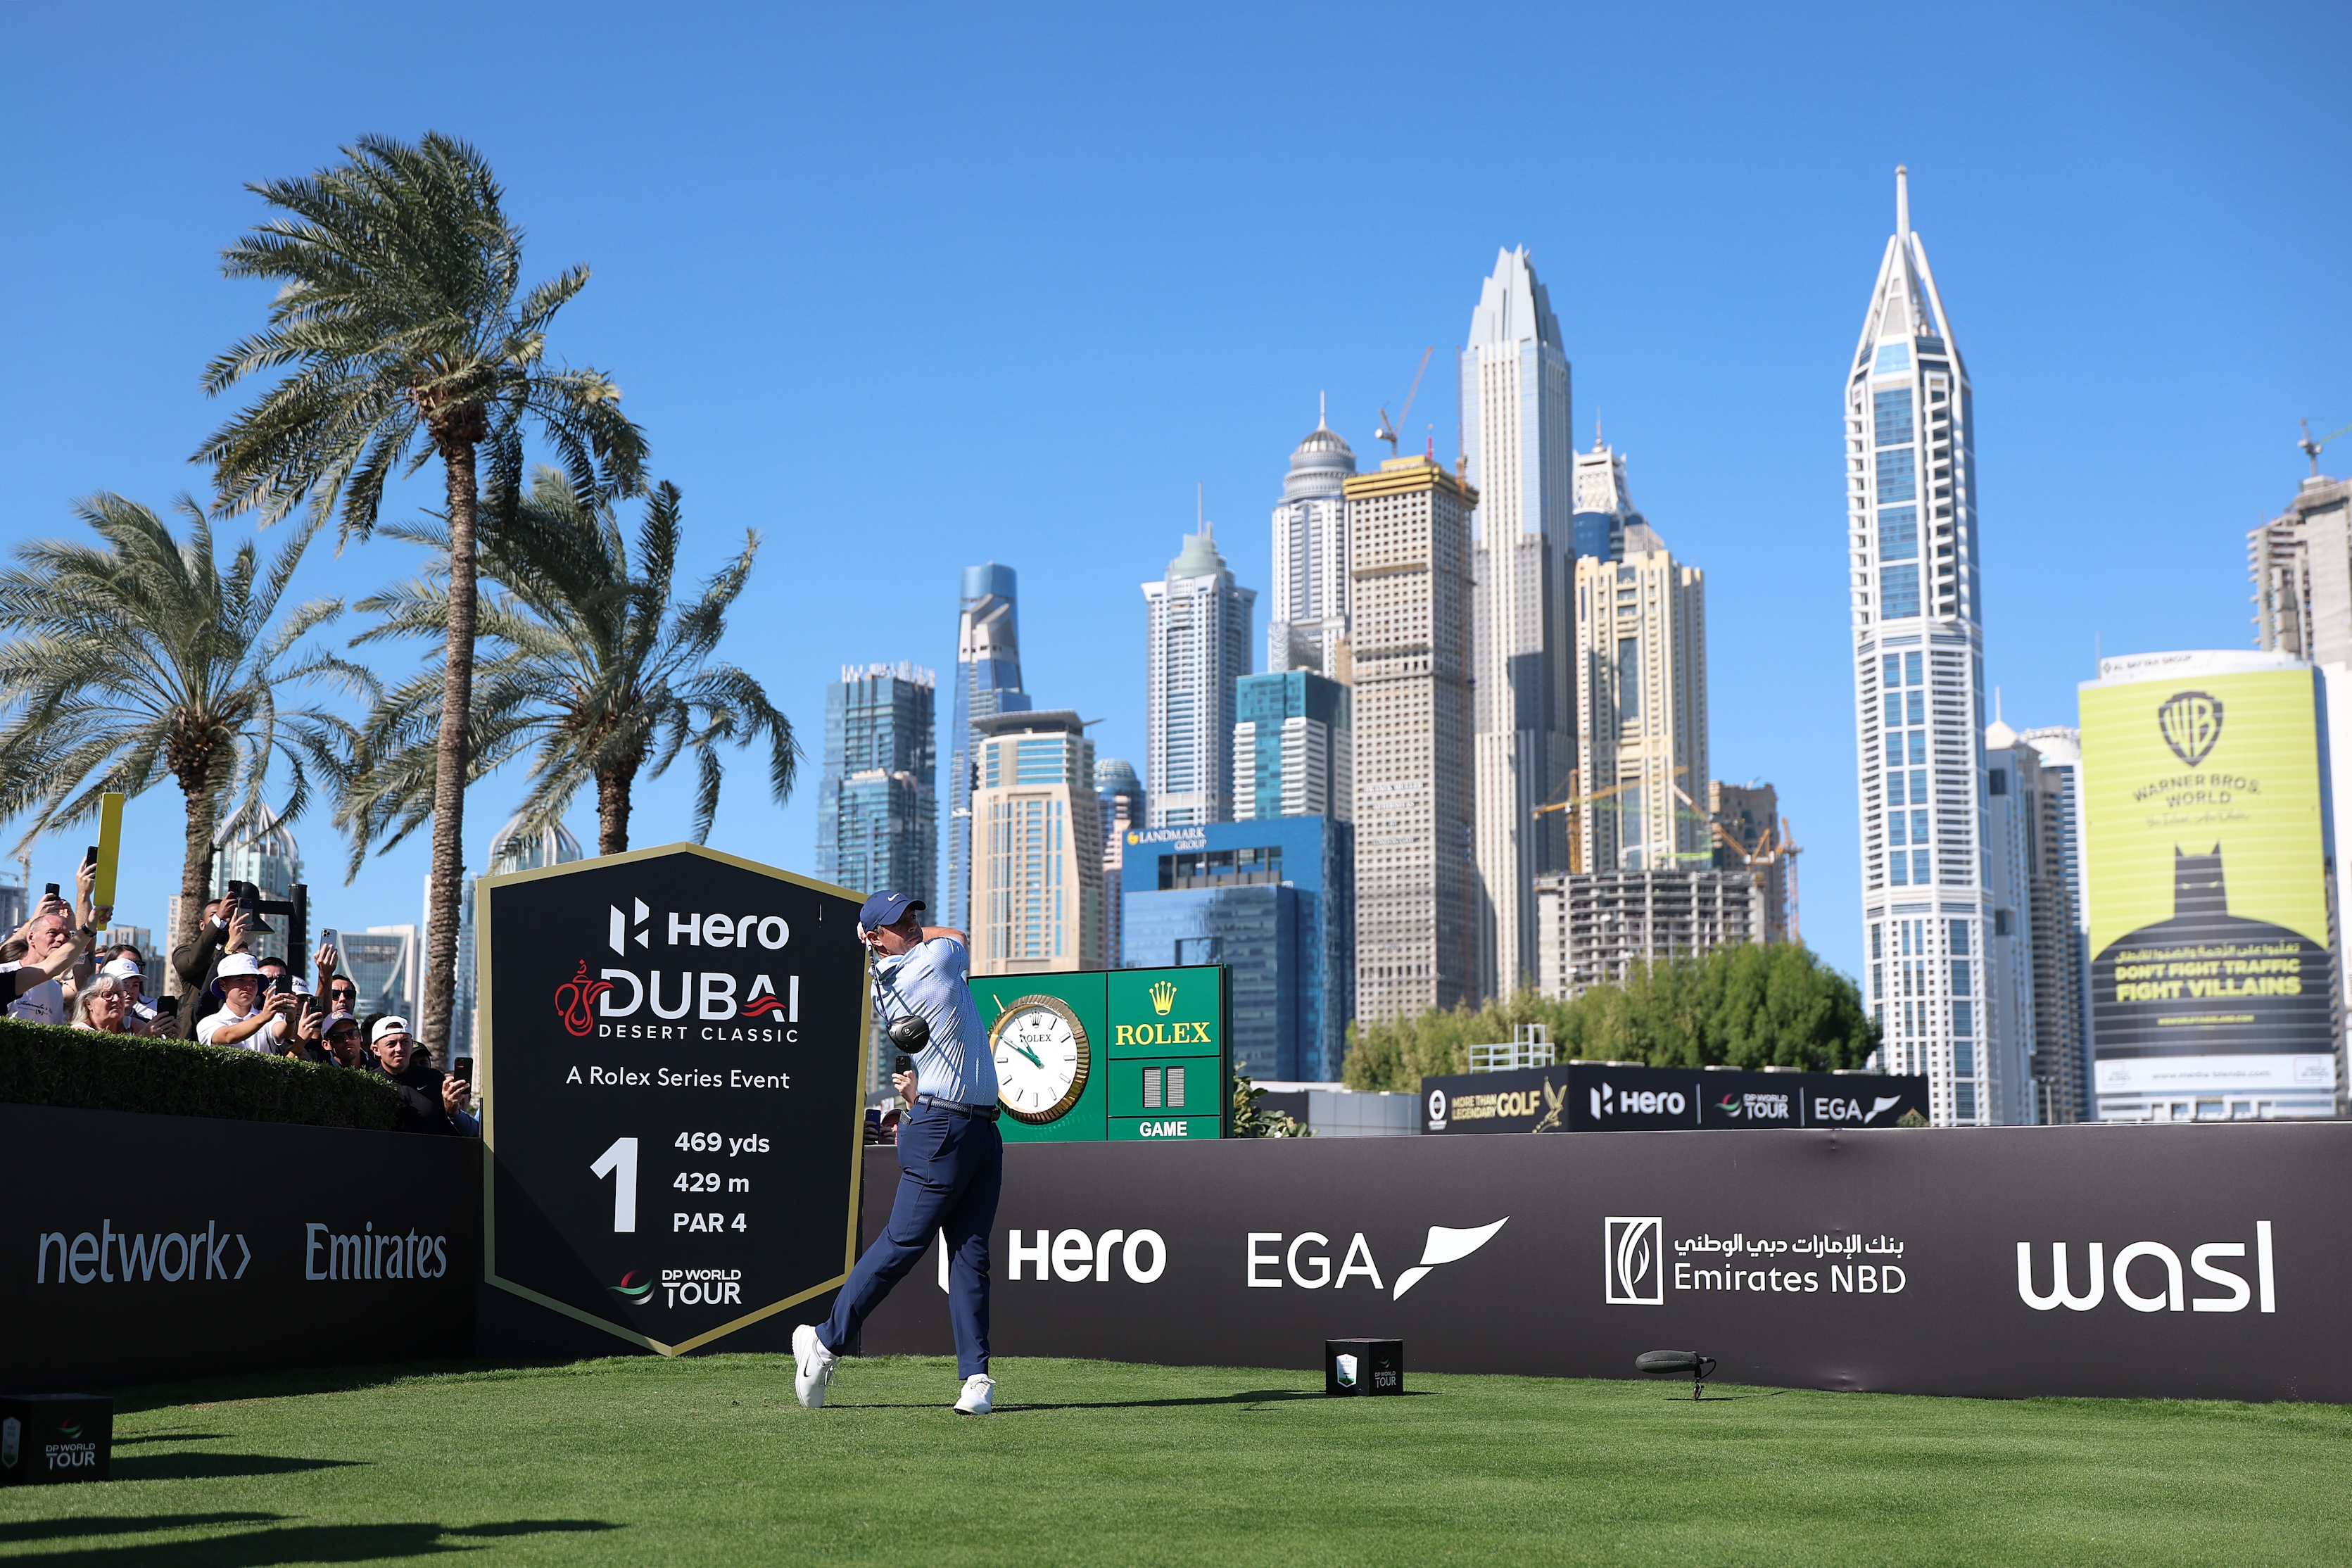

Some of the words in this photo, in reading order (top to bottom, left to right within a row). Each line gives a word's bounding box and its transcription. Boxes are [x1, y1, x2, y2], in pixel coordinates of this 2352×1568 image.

[2163, 697, 2217, 758] WB
[2133, 775, 2206, 802] WARNER
[2211, 774, 2262, 795] BROS.
[2166, 784, 2232, 807] WORLD
[1139, 827, 1206, 844] LANDMARK
[1174, 839, 1207, 851] GROUP
[668, 912, 790, 950] Hero
[2115, 963, 2166, 981] DON'T
[2168, 961, 2220, 978] FIGHT
[2223, 958, 2301, 975] TRAFFIC
[600, 968, 799, 1023] DUBAI
[2116, 980, 2184, 1002] FIGHT
[2187, 976, 2302, 997] VILLAINS
[600, 1024, 687, 1040] DESERT
[702, 1026, 798, 1043] CLASSIC
[1115, 1022, 1211, 1046] ROLEX
[566, 1066, 583, 1085] A
[590, 1066, 651, 1087] Rolex
[657, 1068, 723, 1088] Series
[731, 1070, 790, 1089] Event
[1452, 1096, 1474, 1108] MORE
[1475, 1094, 1497, 1106] THAN
[1497, 1090, 1541, 1118] GOLF
[1621, 1089, 1686, 1115] Hero
[1743, 1094, 1757, 1102] DP
[1757, 1094, 1788, 1102] WORLD
[1814, 1098, 1863, 1120] EGA
[1452, 1106, 1497, 1120] LEGENDARY
[1744, 1101, 1789, 1120] TOUR
[1139, 1121, 1187, 1137] GAME
[674, 1132, 723, 1151] 469
[729, 1133, 770, 1156] yds
[590, 1137, 638, 1232] 1
[673, 1173, 721, 1192] 429
[728, 1177, 750, 1192] m
[674, 1213, 724, 1232] PAR
[731, 1214, 747, 1232] 4
[305, 1221, 447, 1280] Emirates
[1009, 1228, 1167, 1284] Hero
[1674, 1234, 1743, 1258] الوطني
[1746, 1237, 1788, 1258] دبي
[1792, 1234, 1861, 1260] الإمارات
[1865, 1234, 1904, 1259] بنك
[1247, 1232, 1384, 1289] EGA
[2018, 1221, 2275, 1313] wasl
[662, 1270, 682, 1281] DP
[683, 1270, 742, 1281] WORLD
[1674, 1263, 1819, 1292] Emirates
[1831, 1265, 1906, 1294] NBD
[662, 1282, 742, 1309] TOUR
[1375, 1377, 1396, 1389] TOUR
[61, 1443, 96, 1451] WORLD
[46, 1451, 96, 1470] TOUR
